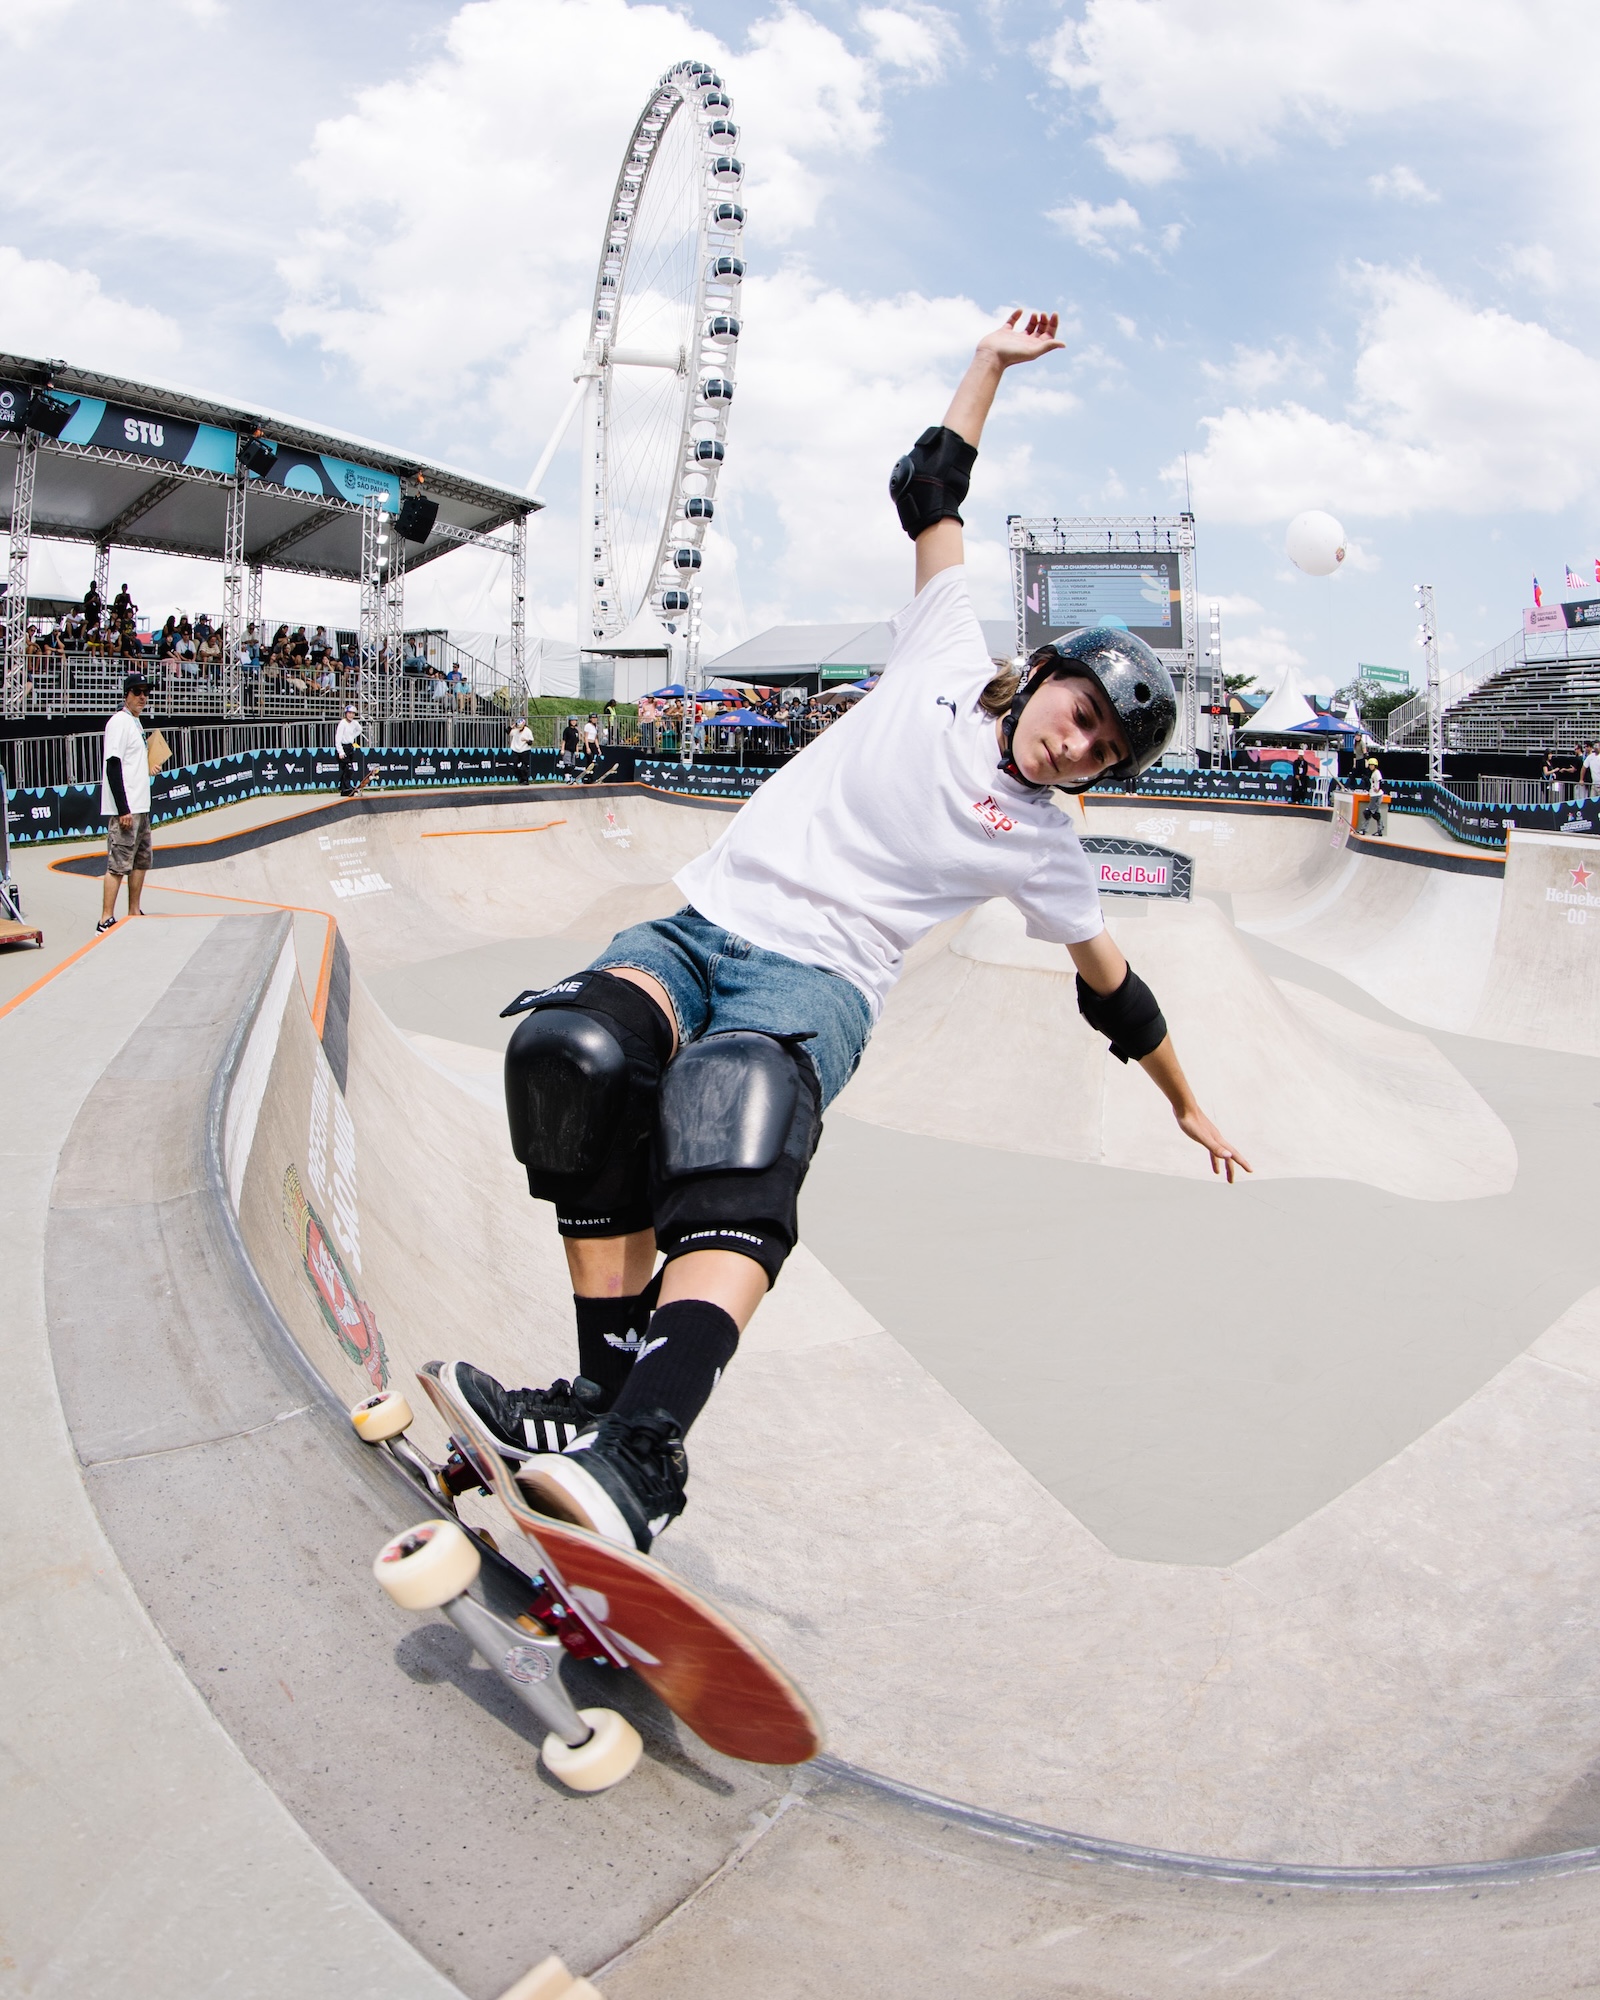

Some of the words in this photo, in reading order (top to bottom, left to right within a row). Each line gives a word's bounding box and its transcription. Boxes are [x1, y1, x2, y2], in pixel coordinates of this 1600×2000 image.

[0, 414, 15, 422] KATE
[124, 418, 164, 447] STU
[357, 475, 382, 487] PREFEITURA
[357, 481, 369, 490] SÃO
[370, 485, 389, 495] PAULO
[440, 761, 451, 770] STU
[481, 761, 491, 769] STU
[31, 806, 51, 819] STU
[1502, 818, 1516, 828] STU
[333, 836, 366, 845] PETROBRAS
[340, 859, 362, 867] ESPORTE
[1101, 865, 1132, 882] Red
[1135, 867, 1166, 884] Bull
[329, 873, 393, 898] BRASIL
[1546, 887, 1600, 907] Heineke
[308, 1065, 328, 1209] PREFEITURA
[333, 1093, 356, 1199] PAULO
[328, 1171, 362, 1275] SÃO
[557, 1217, 573, 1225] NEE
[575, 1217, 611, 1225] GASKET
[690, 1230, 717, 1240] KNEE
[719, 1229, 764, 1246] GASKET
